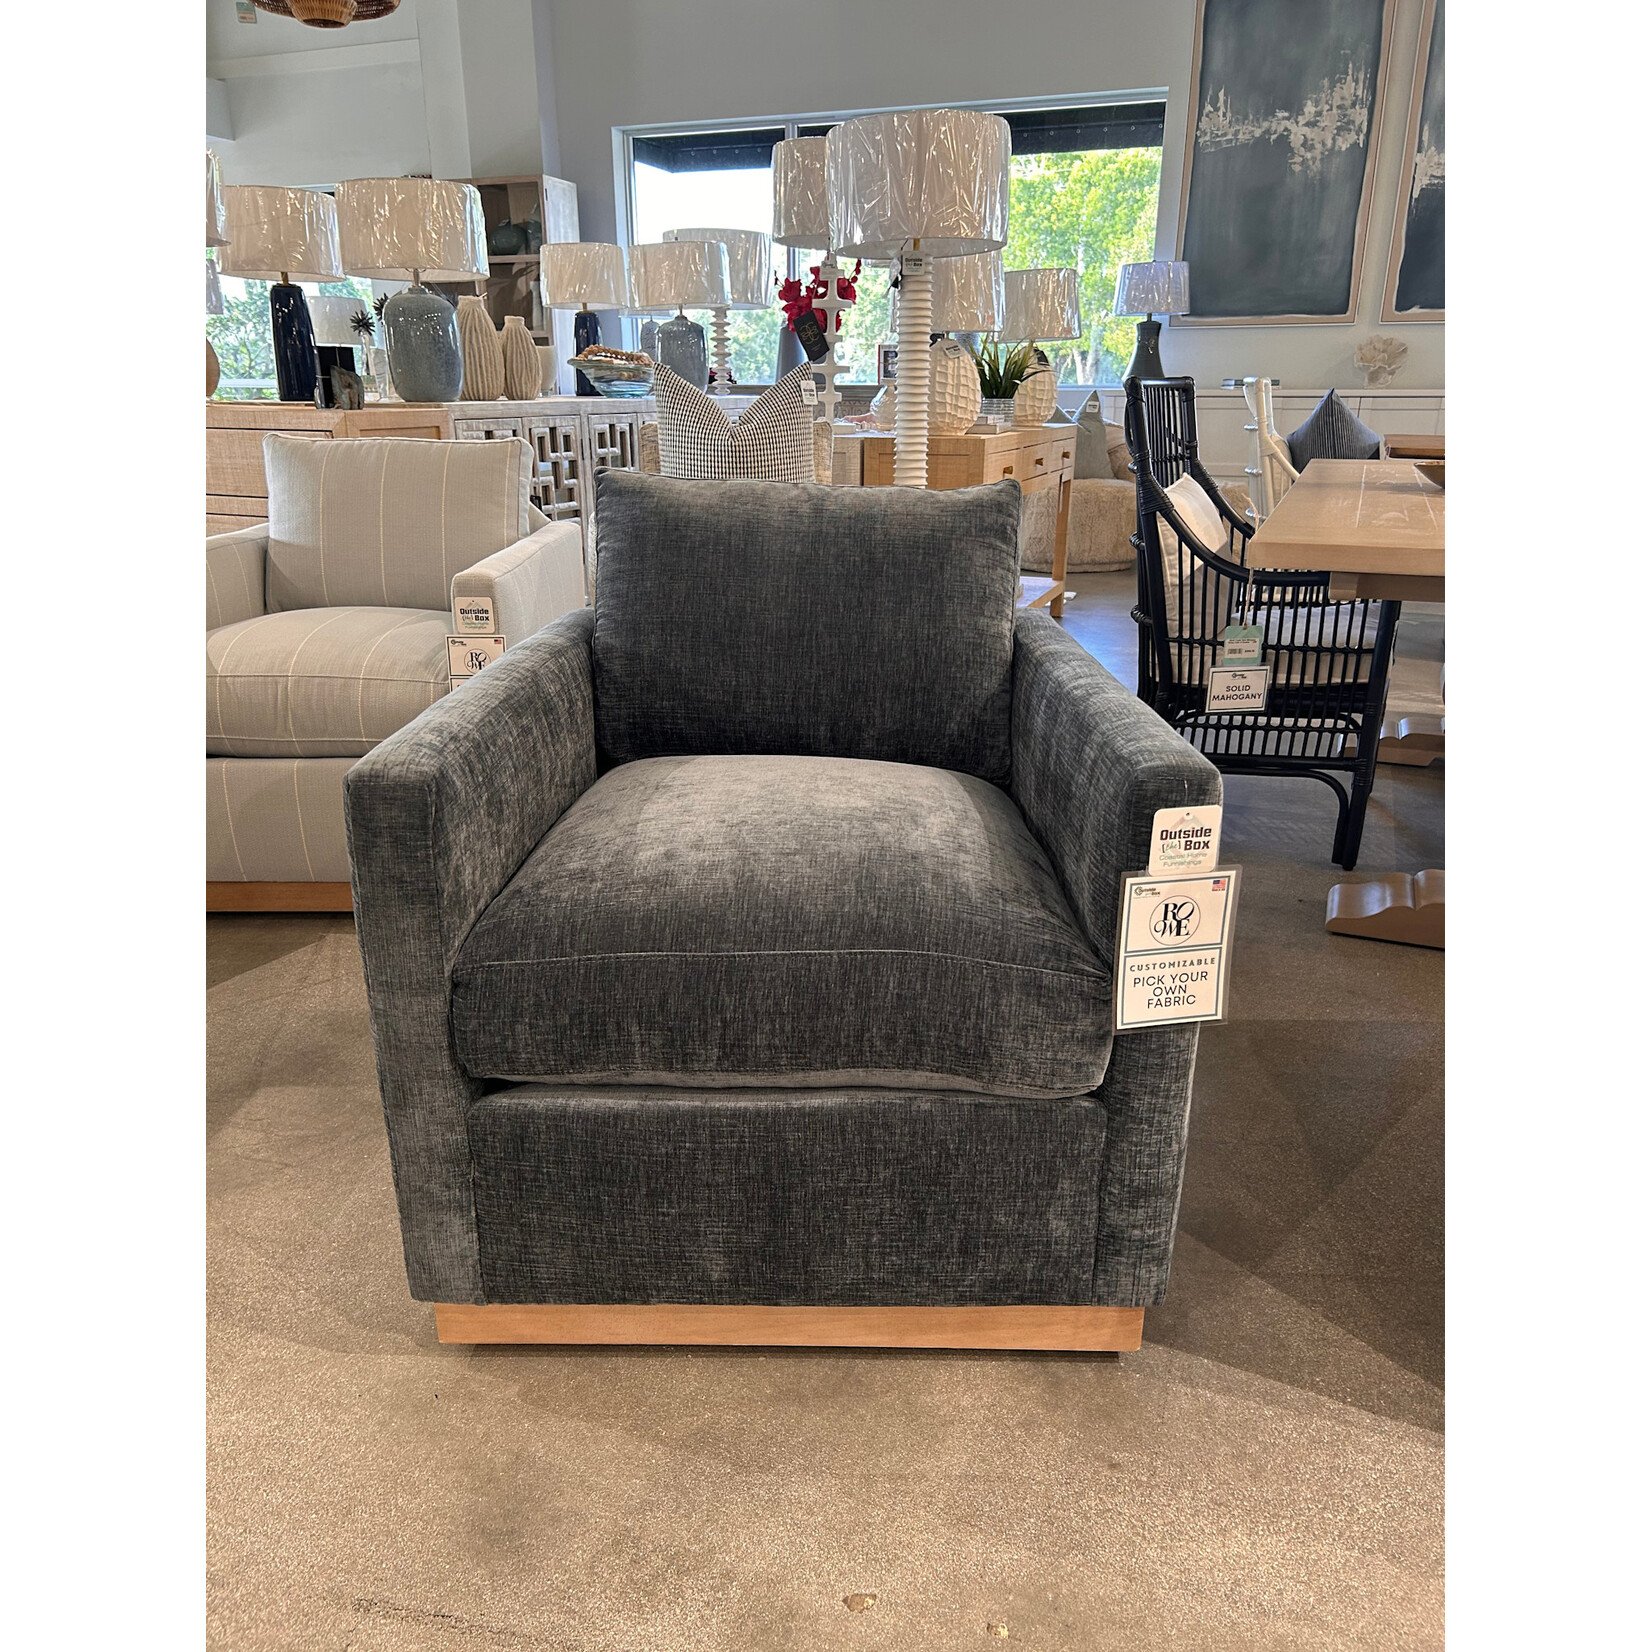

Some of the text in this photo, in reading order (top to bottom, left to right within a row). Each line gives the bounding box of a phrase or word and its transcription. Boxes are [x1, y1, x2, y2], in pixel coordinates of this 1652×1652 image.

[474, 614, 490, 622] Box
[1225, 684, 1251, 692] SOLID
[1211, 692, 1263, 702] MAHOGANY
[1159, 826, 1212, 841] Outside
[1184, 839, 1210, 851] Box
[1129, 957, 1216, 972] CUSTOMIZABLE
[1133, 971, 1209, 988] PICK YOUR
[1152, 984, 1187, 997] OWN
[1147, 994, 1197, 1009] FABRIC
